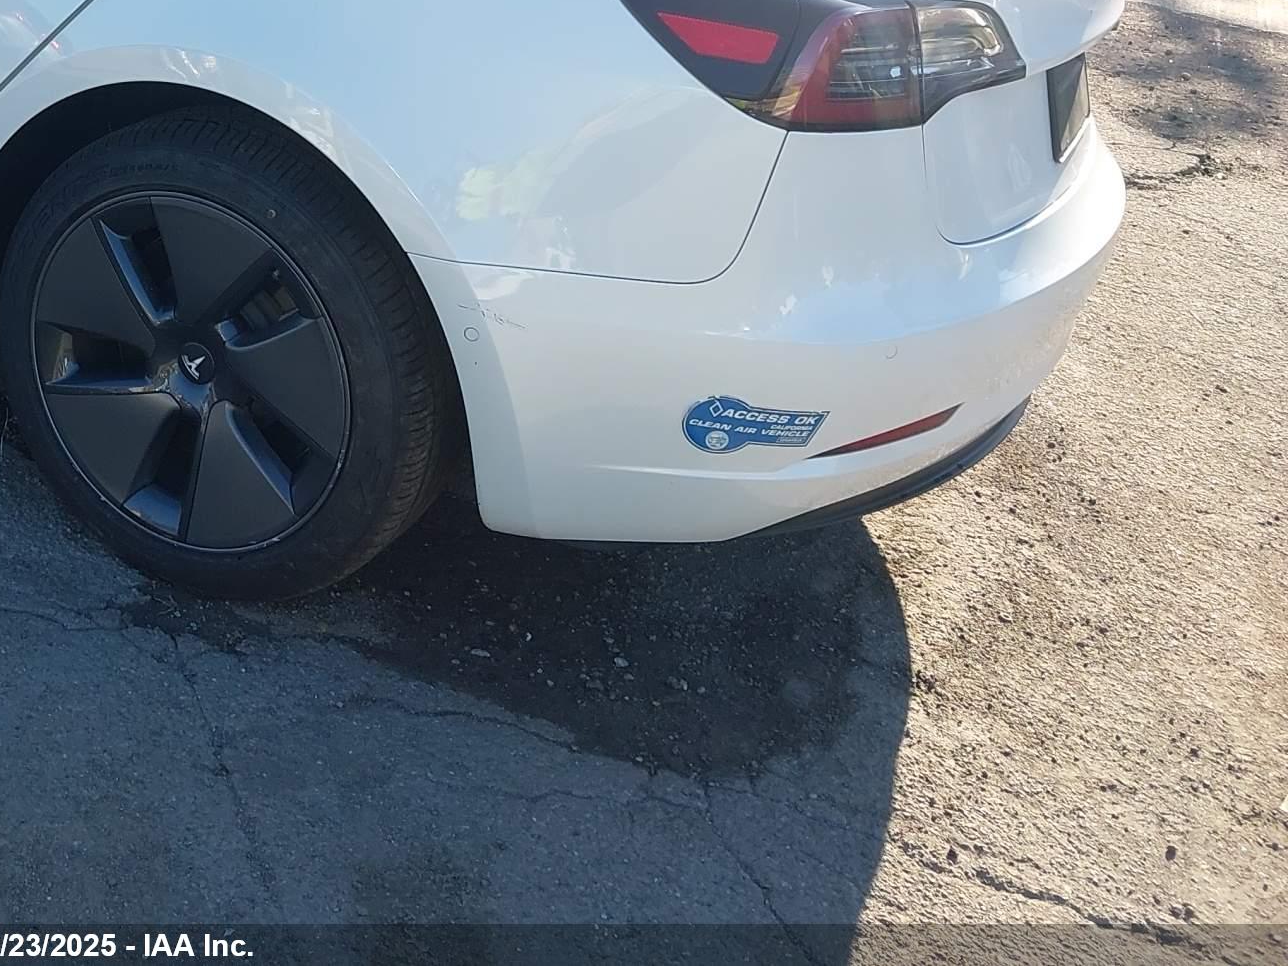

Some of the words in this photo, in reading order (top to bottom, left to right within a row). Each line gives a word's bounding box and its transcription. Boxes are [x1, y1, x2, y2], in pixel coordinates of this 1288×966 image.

[721, 408, 791, 424] ACCESS
[794, 415, 819, 425] OK
[689, 418, 732, 431] CLEAN
[734, 425, 758, 434] AIR
[761, 429, 810, 437] VEHICLE
